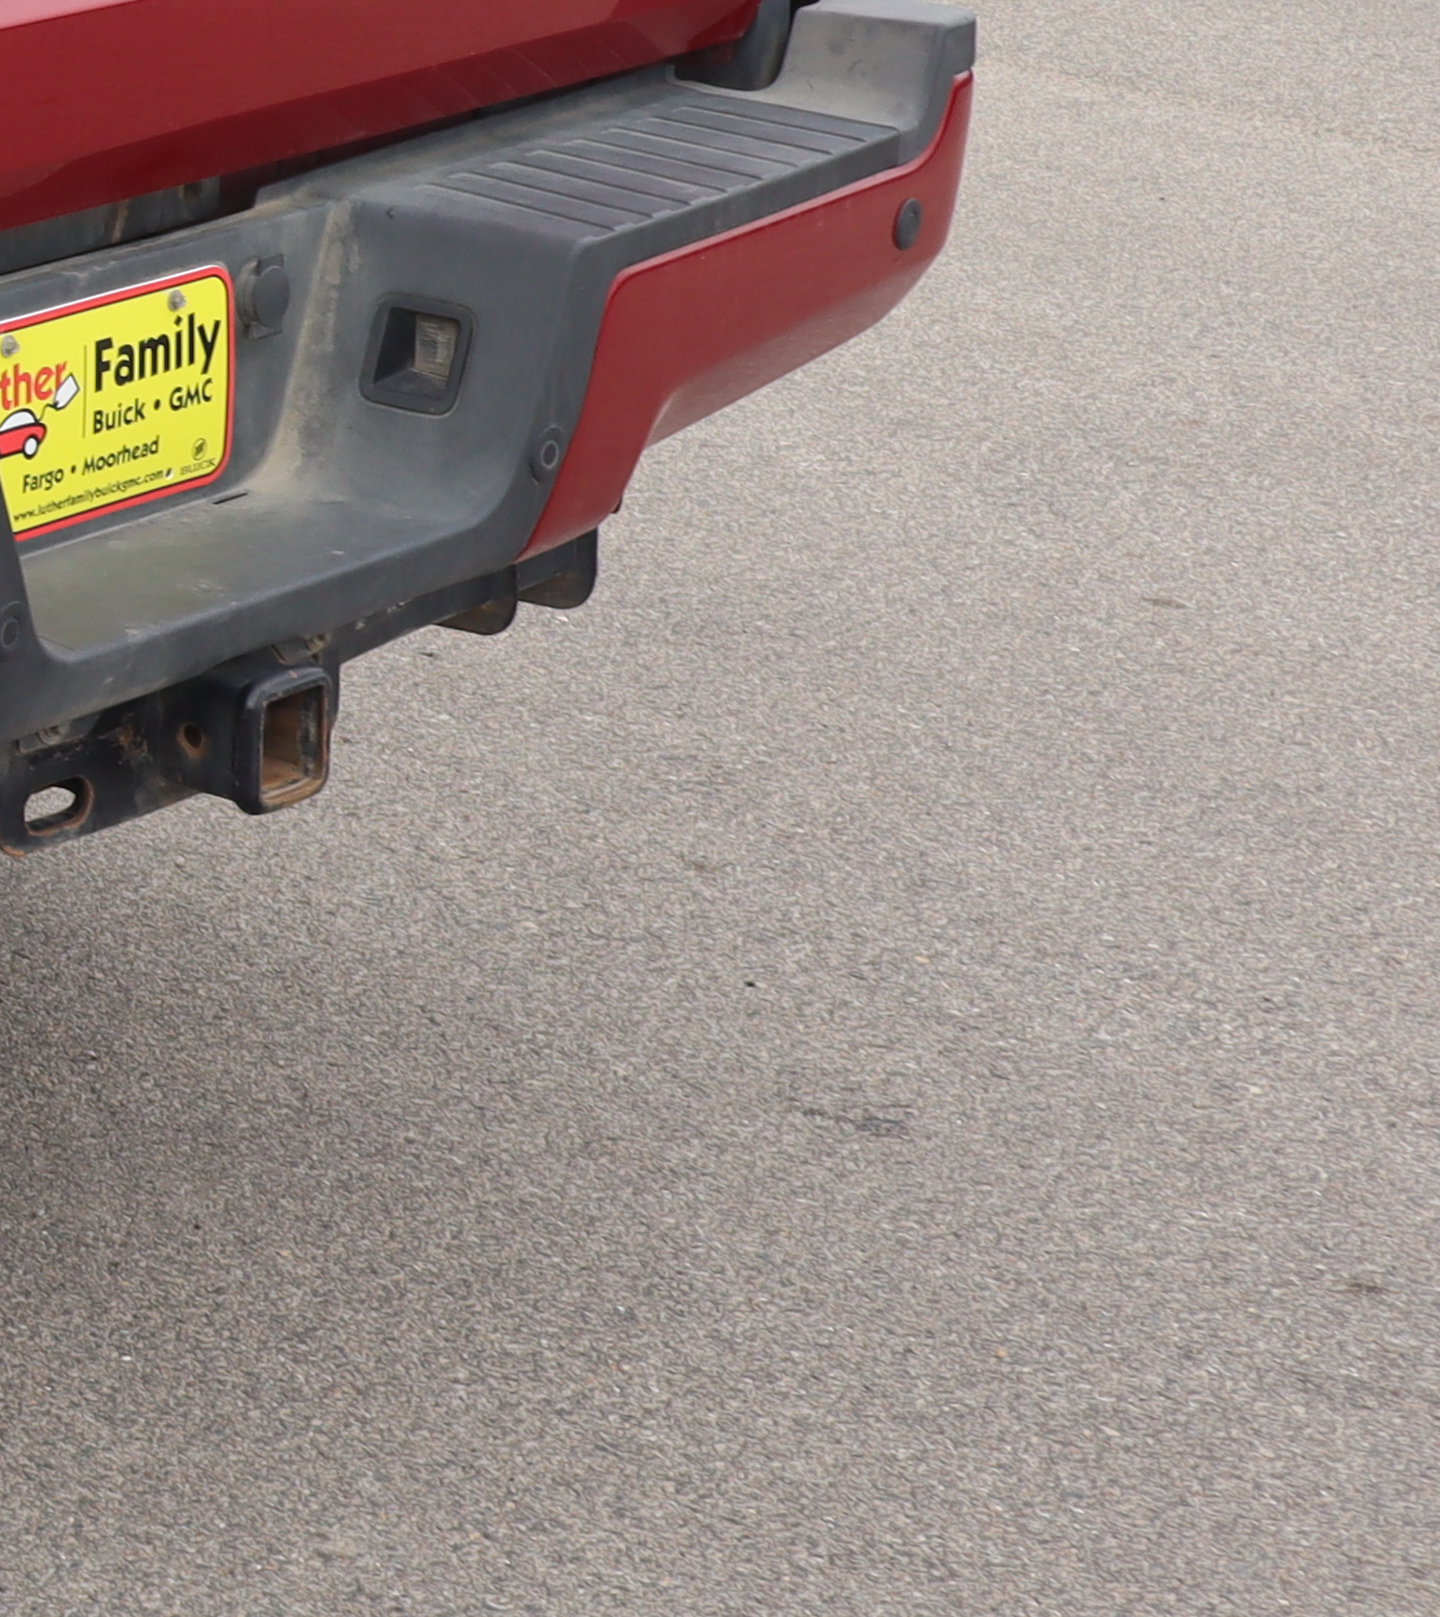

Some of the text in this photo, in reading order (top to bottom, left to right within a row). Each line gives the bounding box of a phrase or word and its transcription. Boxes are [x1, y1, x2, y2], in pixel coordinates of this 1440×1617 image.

[94, 312, 222, 393] Family
[92, 378, 214, 436] Buick GMC
[22, 435, 161, 494] Fargo Moorhead
